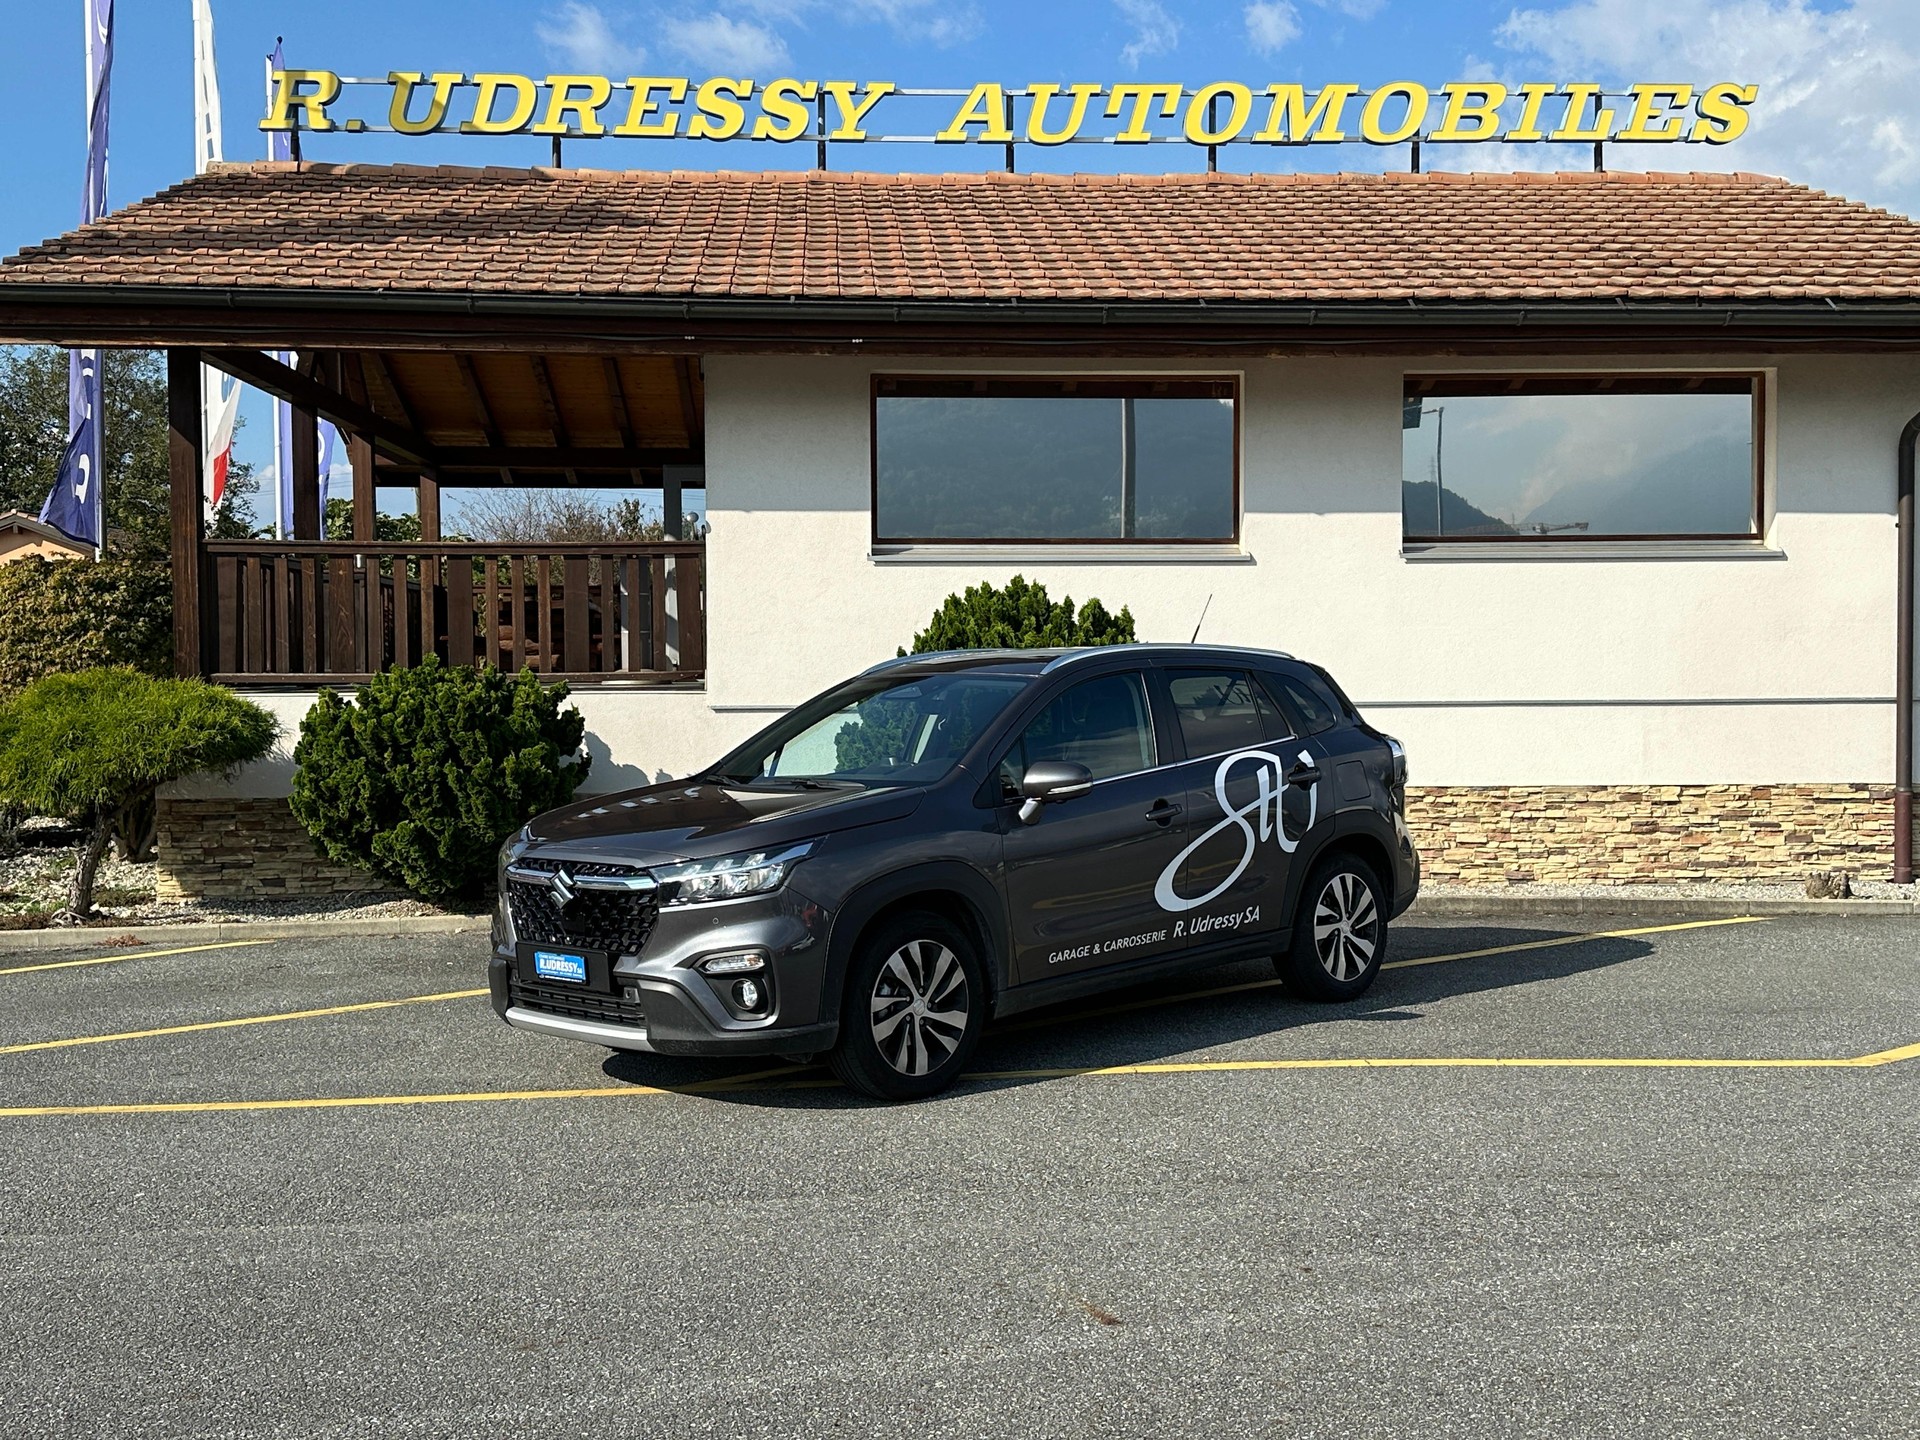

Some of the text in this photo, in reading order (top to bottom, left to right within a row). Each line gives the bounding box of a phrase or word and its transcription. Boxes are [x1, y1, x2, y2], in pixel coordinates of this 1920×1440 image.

[934, 81, 1760, 147] AUTOMOBILES
[1048, 944, 1091, 964] GARAGE
[1092, 943, 1101, 954] &
[1103, 929, 1168, 953] CARROSSERIE
[1189, 911, 1244, 935] Udressy
[1243, 905, 1261, 924] SA
